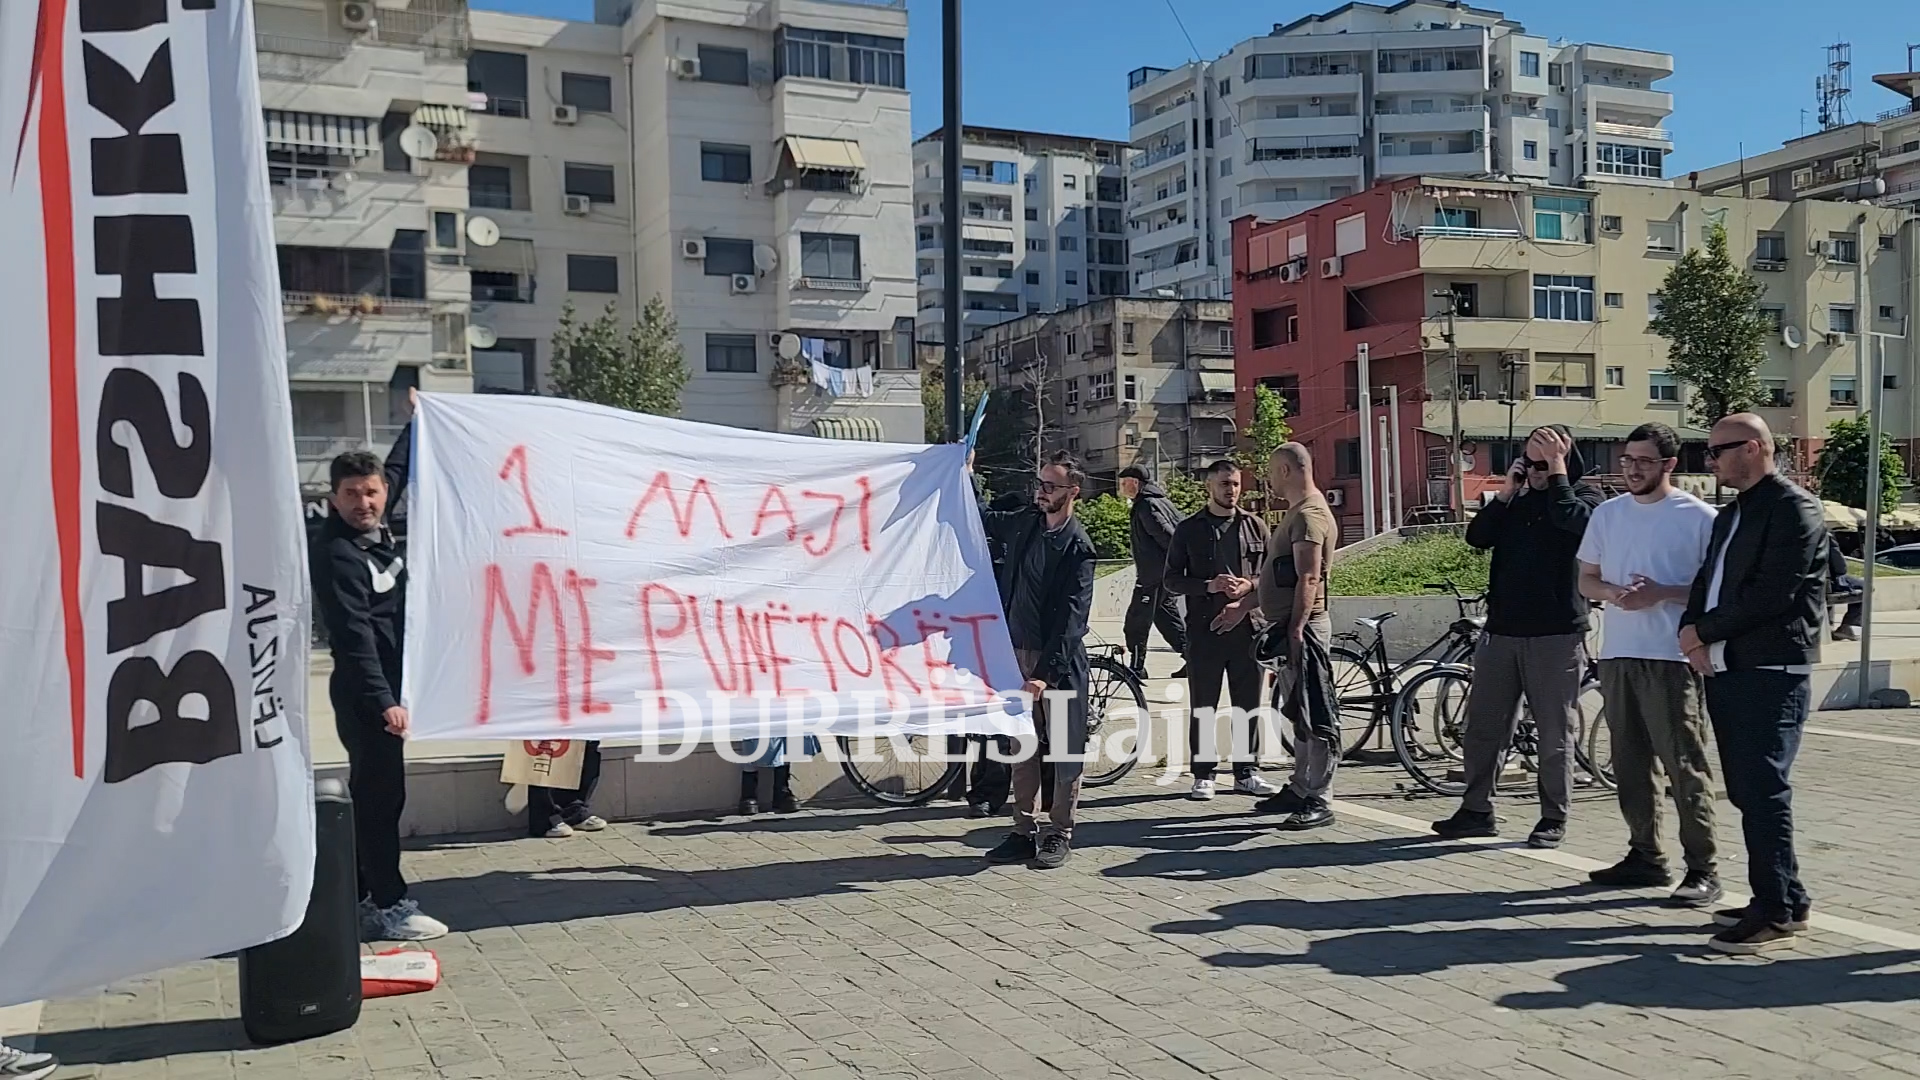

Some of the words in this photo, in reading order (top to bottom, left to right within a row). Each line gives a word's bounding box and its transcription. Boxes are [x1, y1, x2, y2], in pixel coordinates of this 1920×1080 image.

[498, 443, 569, 538] 1
[623, 472, 873, 557] MAJI
[478, 560, 617, 727] ME
[640, 580, 1000, 712] PUNËTORËT
